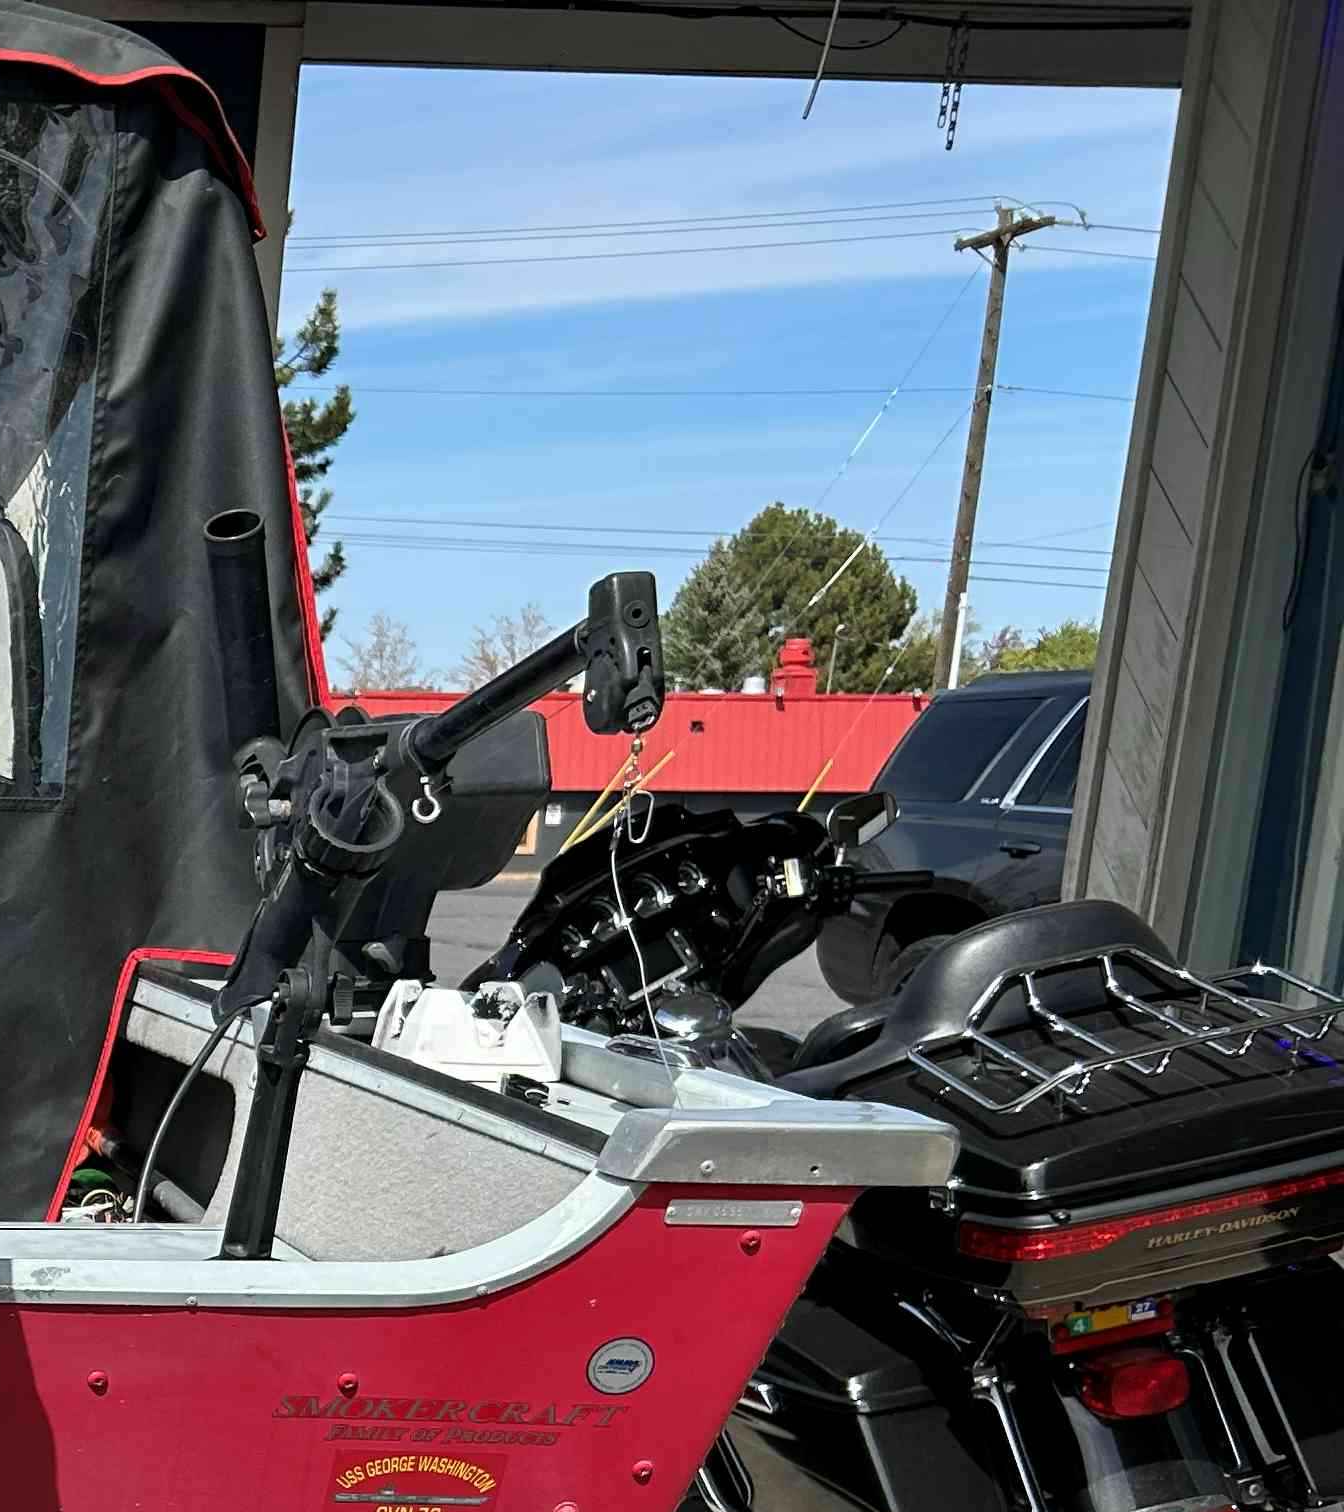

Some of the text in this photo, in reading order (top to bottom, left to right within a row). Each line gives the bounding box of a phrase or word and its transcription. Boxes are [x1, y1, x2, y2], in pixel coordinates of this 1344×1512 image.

[1146, 1206, 1300, 1249] HARLEY-DAVIDSON
[1072, 1318, 1086, 1334] 4
[336, 1455, 497, 1494] USS GEORGE WASHINGTON
